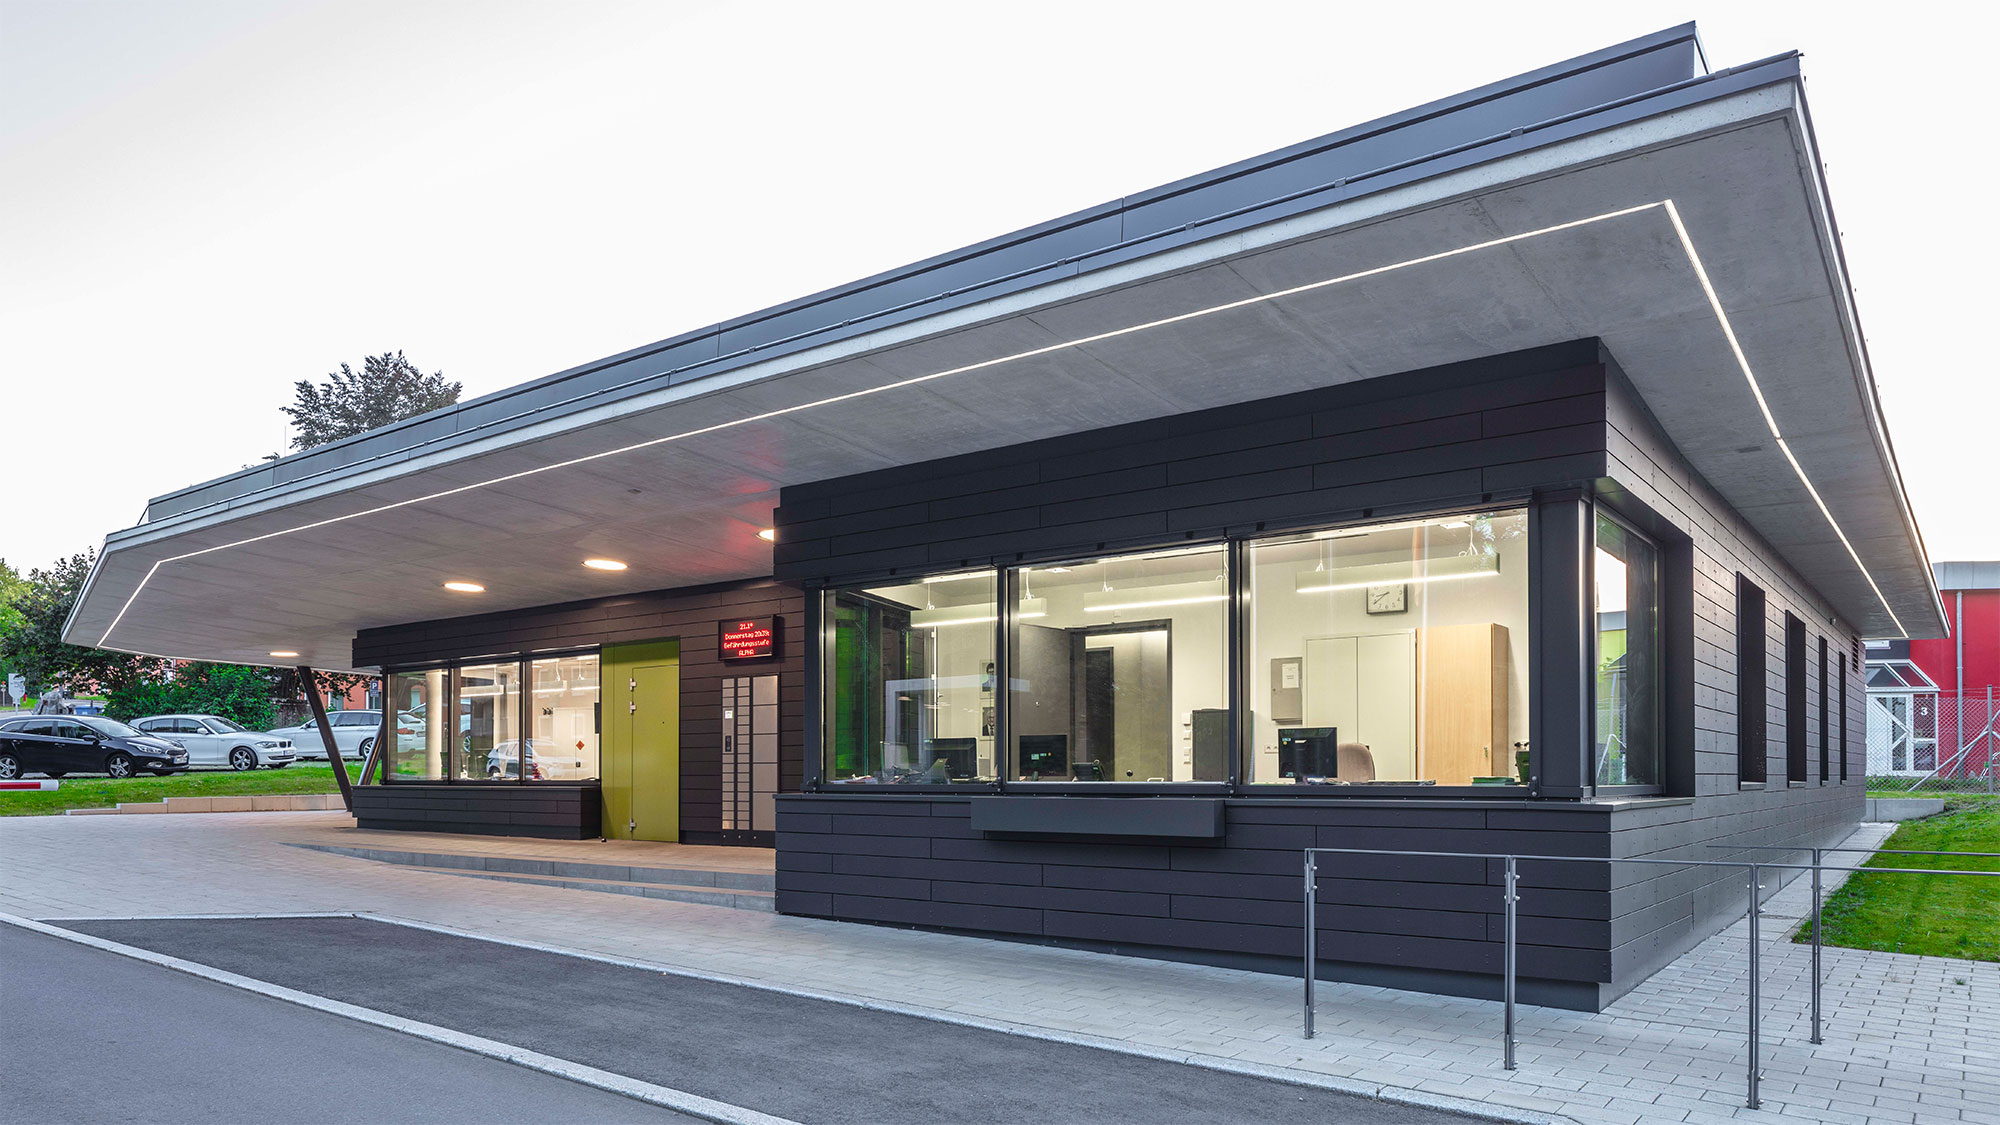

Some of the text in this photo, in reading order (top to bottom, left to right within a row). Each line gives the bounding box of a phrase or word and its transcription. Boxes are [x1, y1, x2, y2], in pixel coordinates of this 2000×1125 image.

[725, 632, 754, 640] Donnerstag
[724, 639, 769, 649] Gefährdungsstufe
[372, 682, 378, 690] P
[1920, 707, 1928, 715] 3
